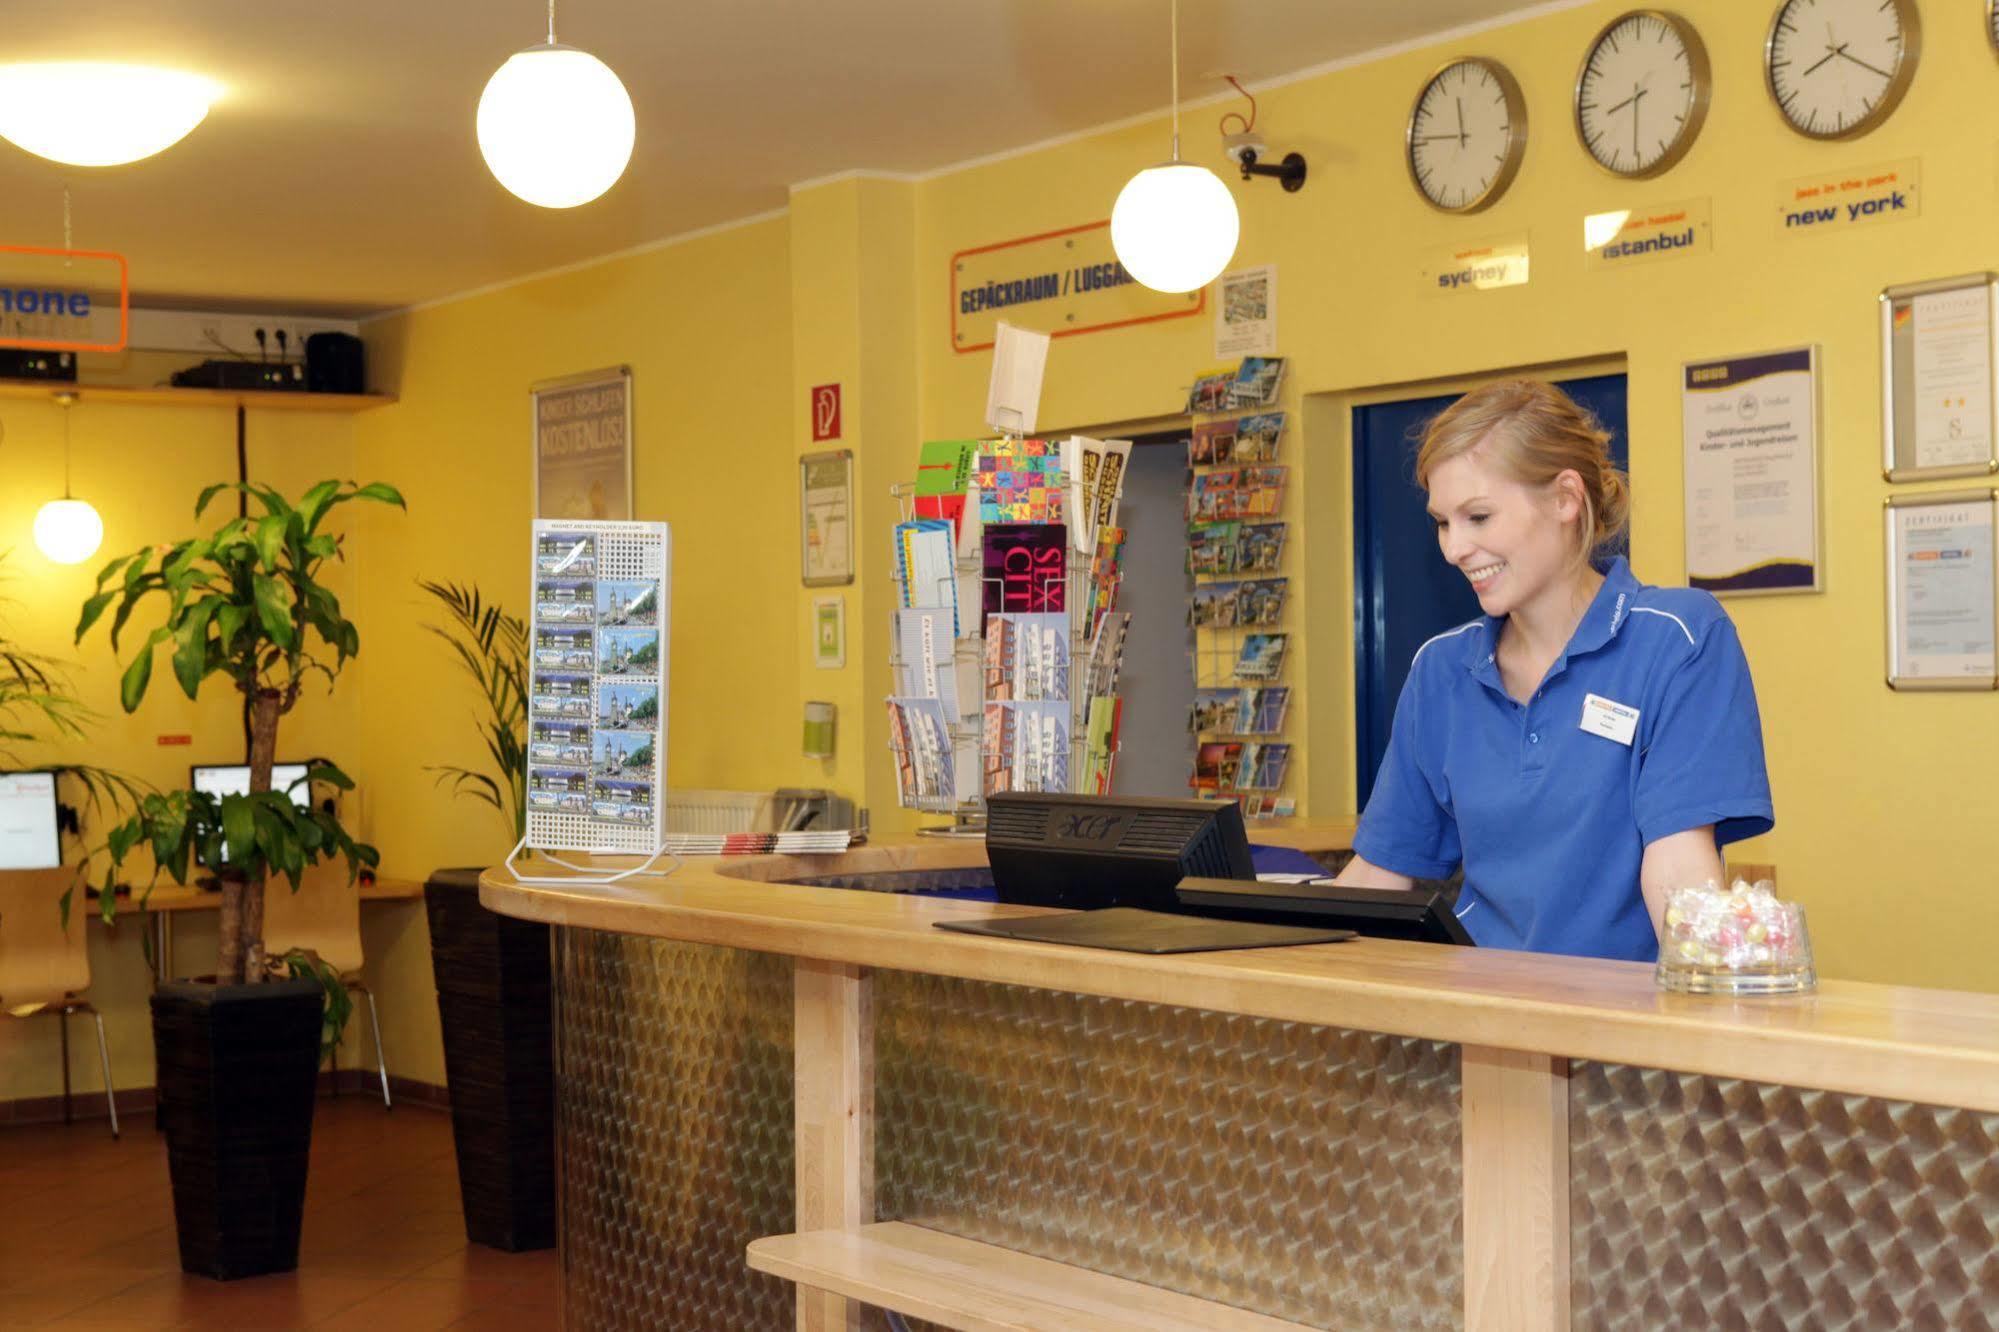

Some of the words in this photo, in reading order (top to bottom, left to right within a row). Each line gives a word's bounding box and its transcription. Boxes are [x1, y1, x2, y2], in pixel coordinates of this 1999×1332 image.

[1786, 206, 1837, 228] new
[1847, 191, 1906, 222] york
[1602, 227, 1695, 260] istanbul
[960, 272, 1059, 315] GEPÄCKRAUM
[1062, 269, 1071, 297] /
[1438, 264, 1508, 289] sydney
[540, 415, 625, 457] KOSTENLOS!
[1004, 545, 1033, 613] CIT
[1033, 547, 1062, 608] SEX
[1056, 815, 1121, 841] acer
